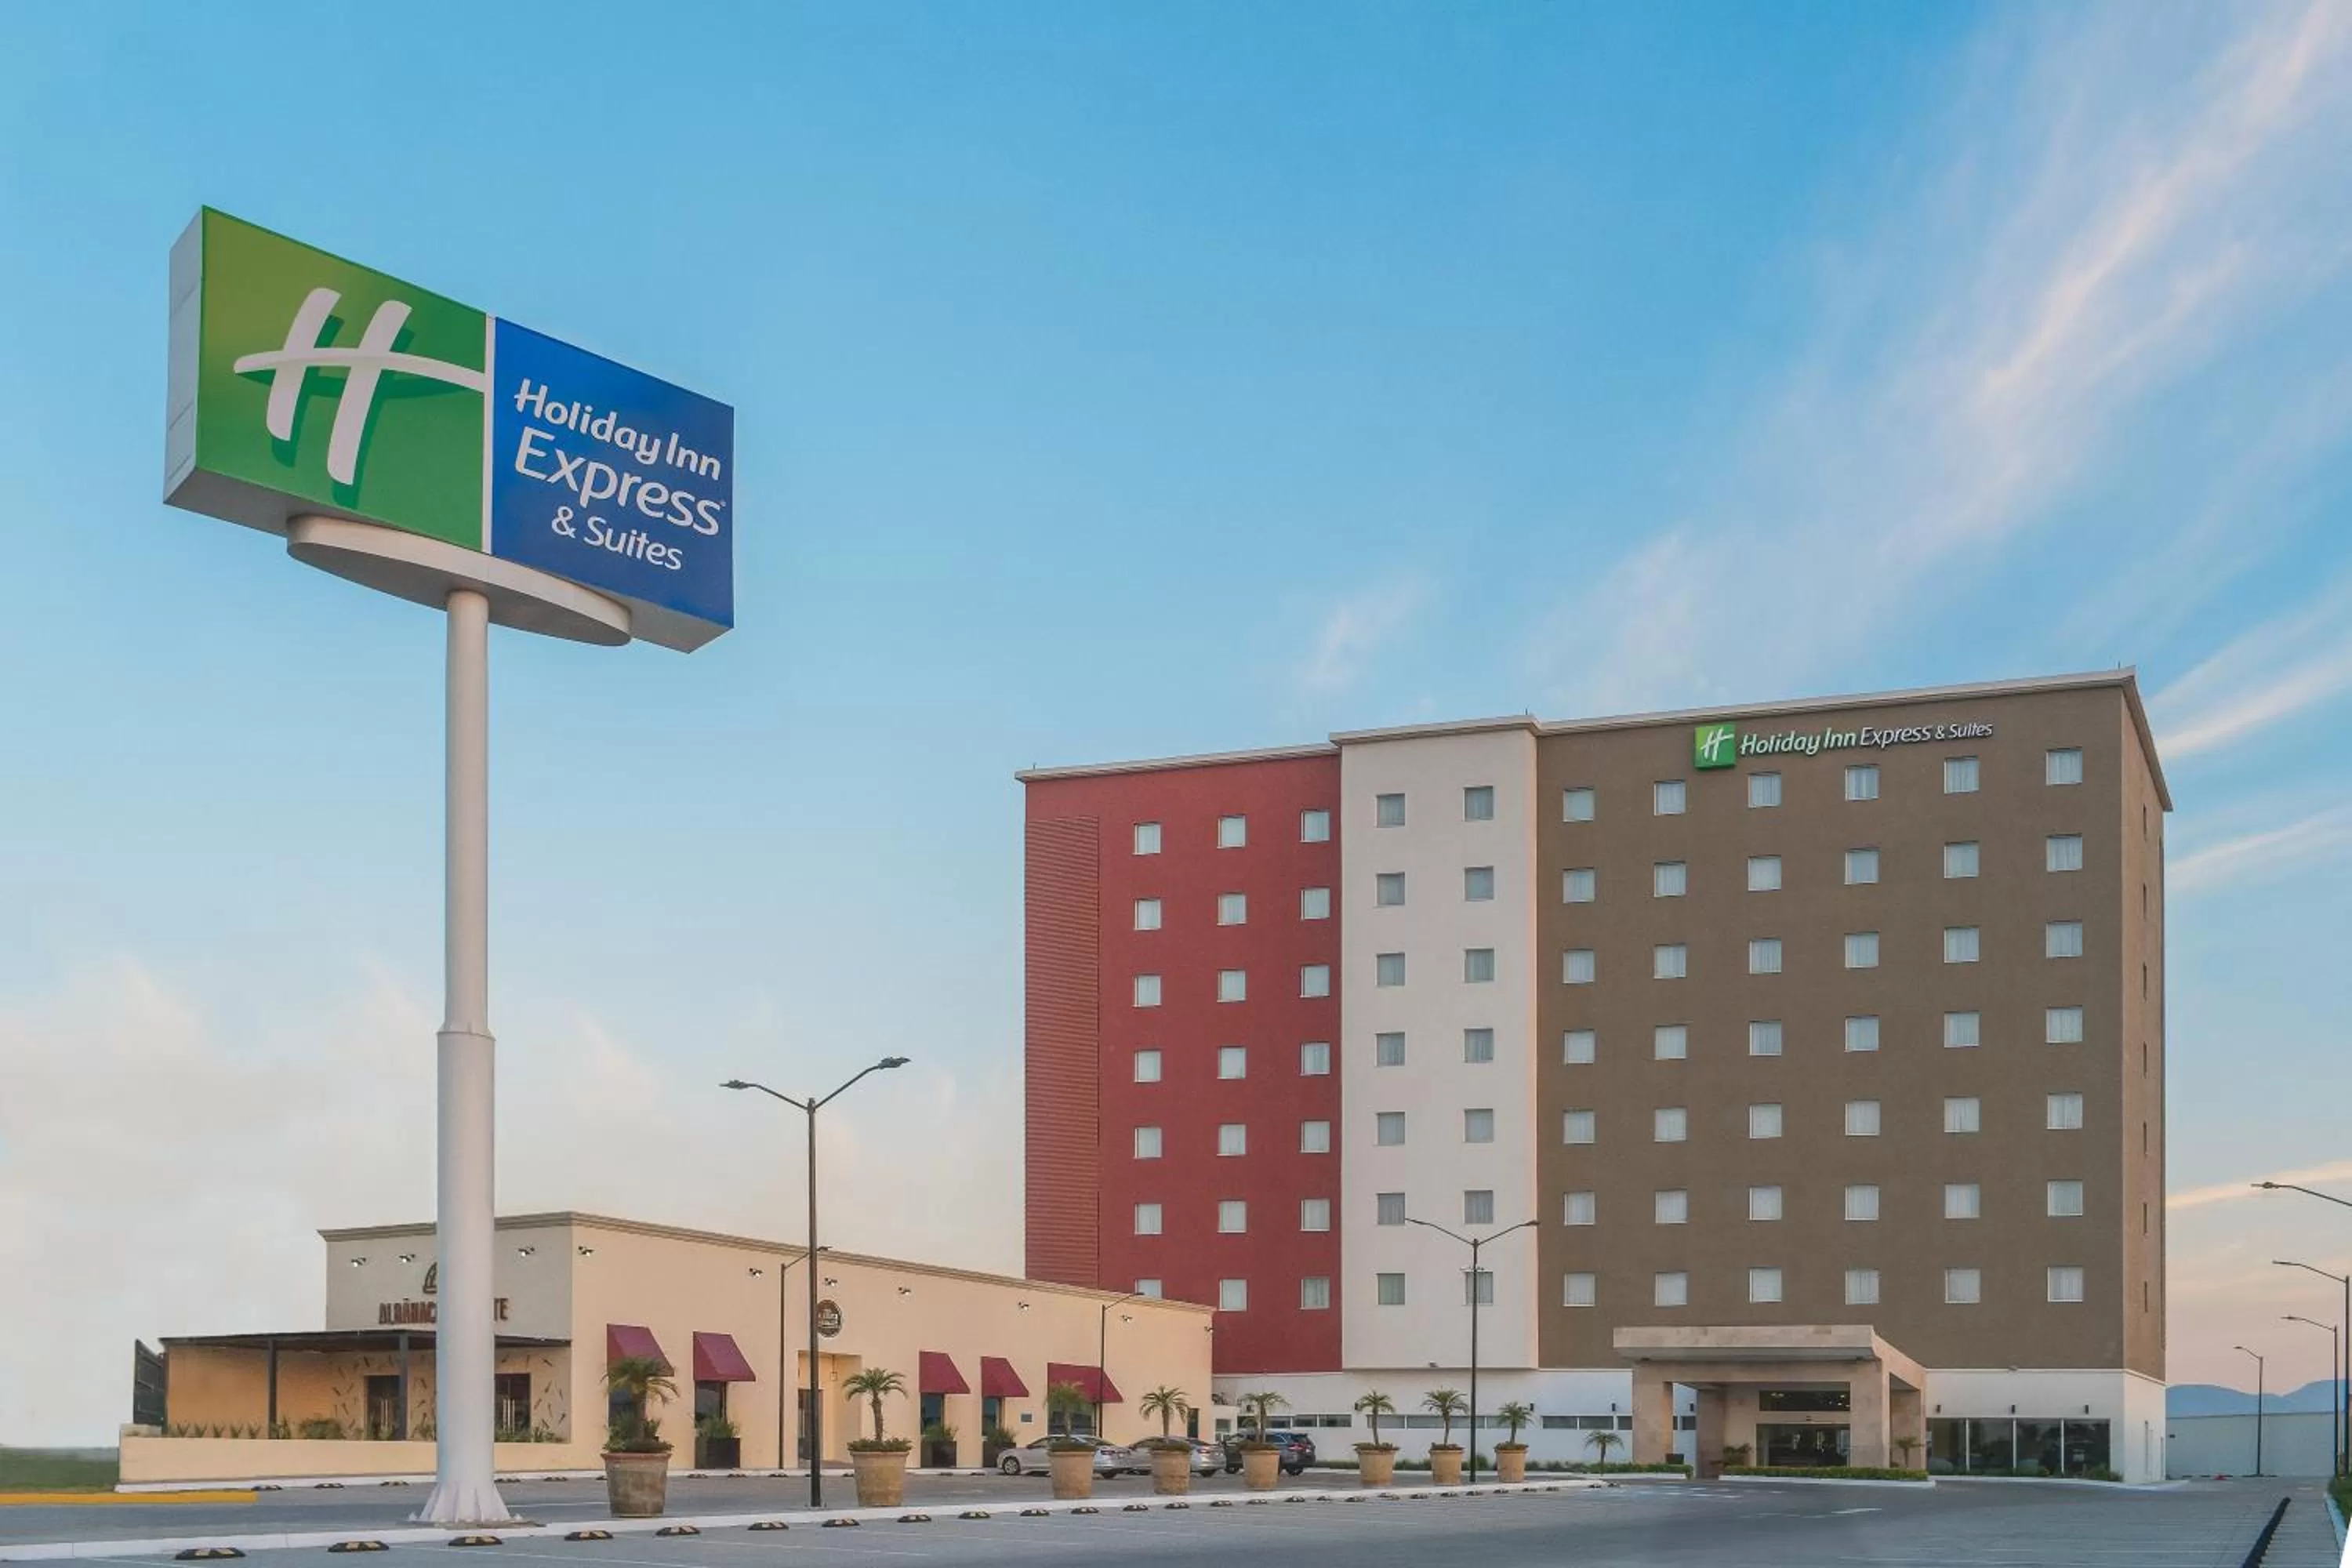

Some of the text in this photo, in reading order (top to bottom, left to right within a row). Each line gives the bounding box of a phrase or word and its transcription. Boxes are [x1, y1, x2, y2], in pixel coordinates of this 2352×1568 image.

[514, 378, 721, 481] Holiday Inn
[514, 426, 721, 536] Express
[551, 506, 683, 570] & Suites
[1740, 721, 1994, 755] Holiday Inn Express & Suites
